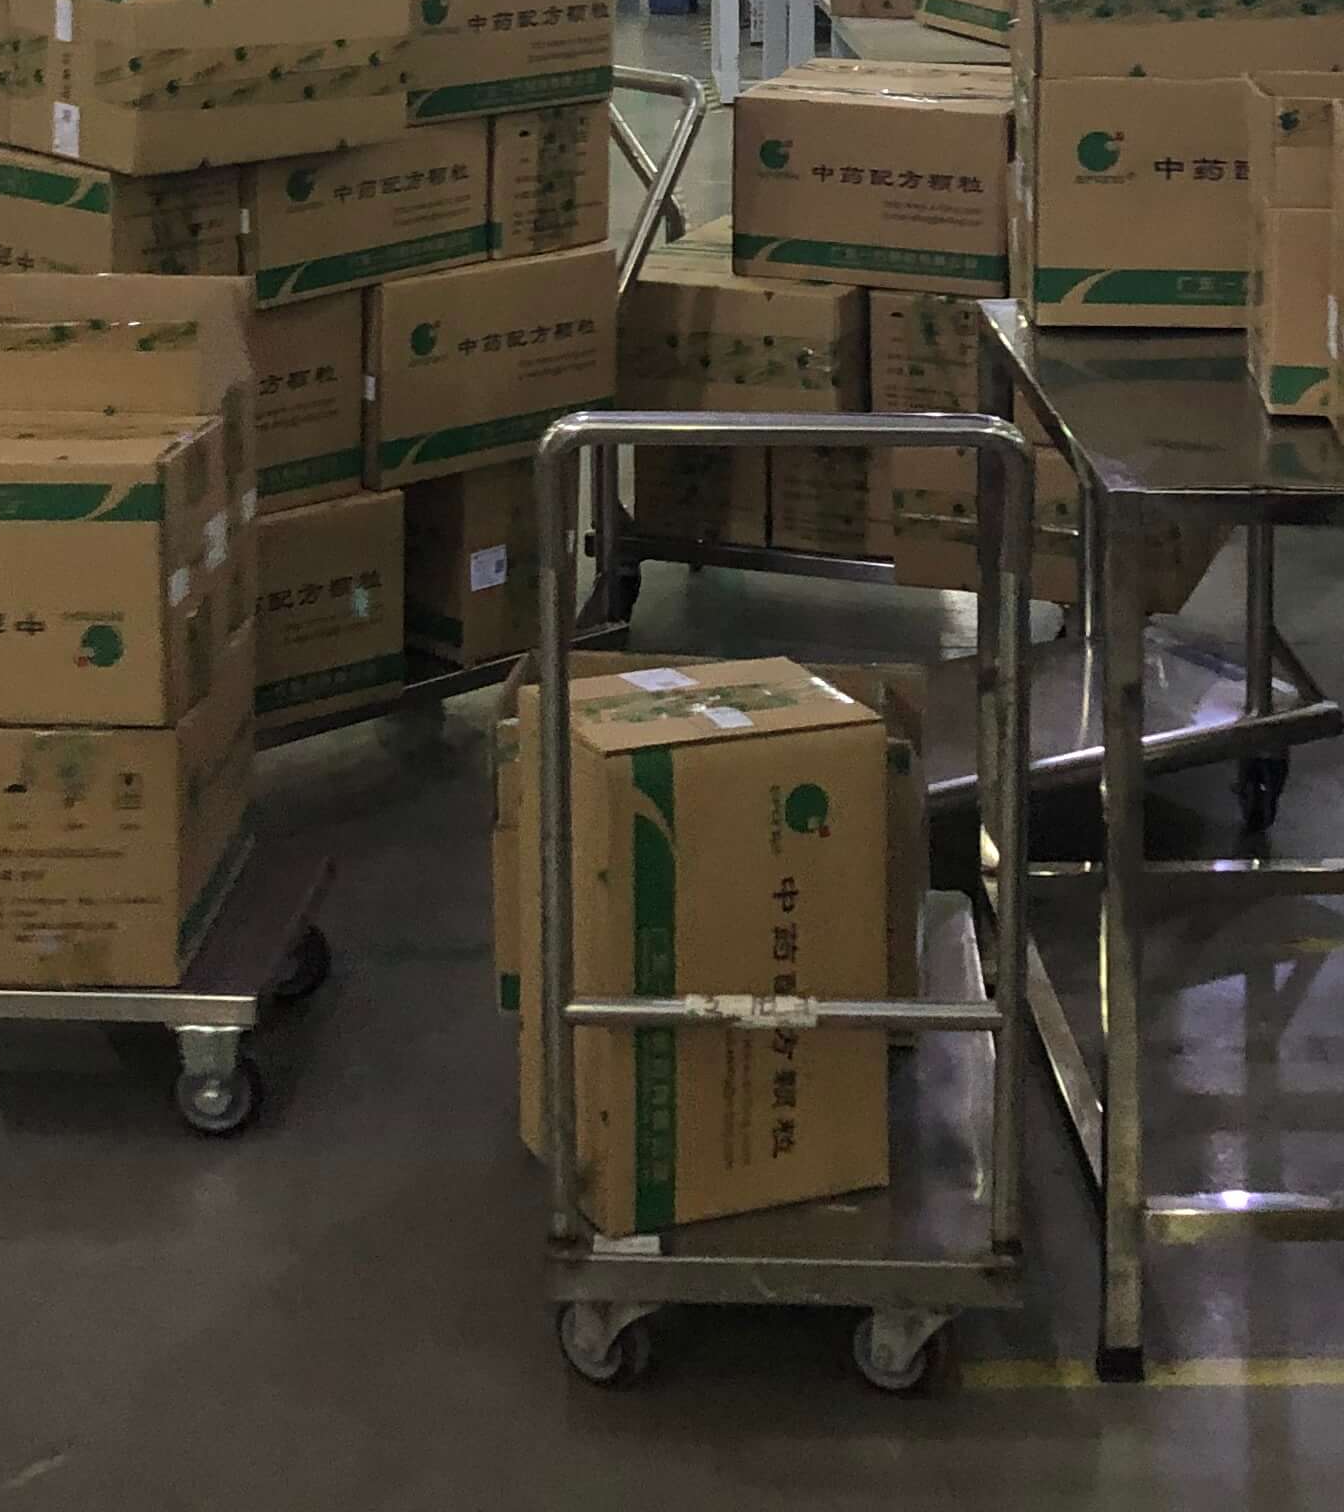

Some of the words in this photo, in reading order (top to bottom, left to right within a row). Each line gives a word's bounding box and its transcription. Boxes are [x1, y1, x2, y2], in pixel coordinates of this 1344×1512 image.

[467, 1, 610, 32] 中药配方颗粒
[333, 162, 470, 203] 中药配方颗粒
[811, 163, 985, 193] 中药配方颗粒
[457, 318, 596, 356] 中药配方颗粒
